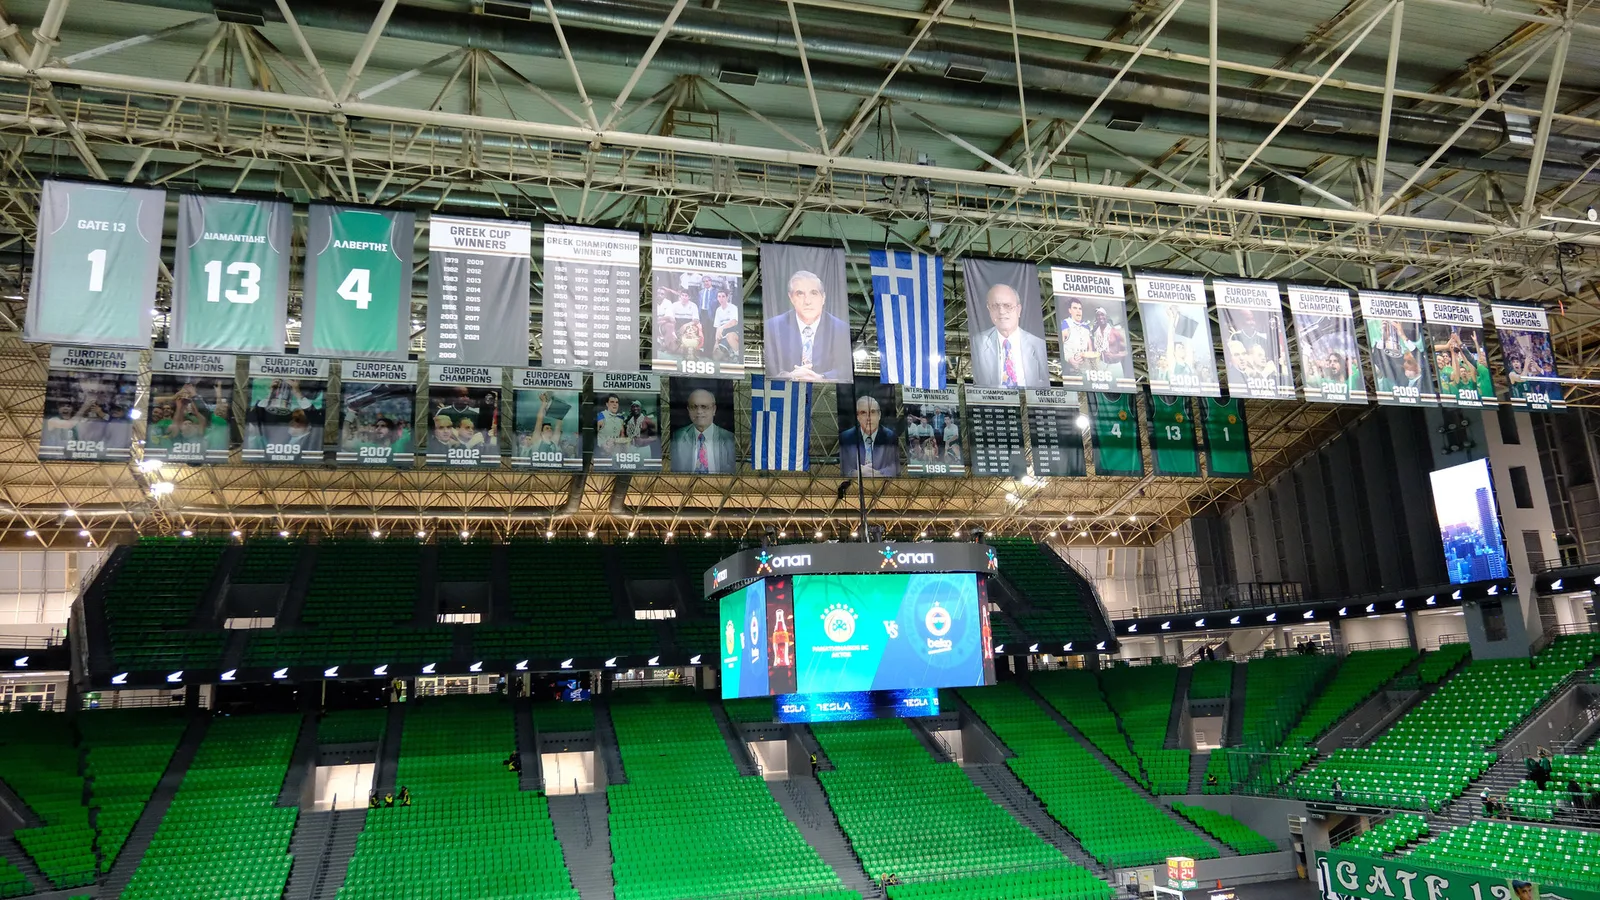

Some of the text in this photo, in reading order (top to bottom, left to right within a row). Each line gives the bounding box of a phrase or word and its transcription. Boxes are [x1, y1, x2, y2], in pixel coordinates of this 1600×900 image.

[77, 220, 126, 233] GATE 13
[203, 232, 266, 244] ΔΙΑΜΑΝΤΙΔΗΣ
[450, 226, 511, 239] GREEK CUP
[333, 239, 388, 252] ΑΛΒΕΡΤΗΣ
[454, 237, 506, 250] WINNERS
[546, 236, 638, 251] GREEK CHAMPIONSHIP
[573, 247, 612, 257] WINNERS
[655, 246, 738, 262] INTERCONTINENTAL
[666, 256, 727, 269] CUP WINNERS
[87, 248, 107, 292] 1
[204, 260, 262, 304] 13
[1065, 274, 1110, 286] EUROPEAN
[336, 268, 372, 310] 4
[1063, 282, 1114, 295] CHAMPIONS
[1149, 282, 1192, 292] EUROPEAN
[1148, 290, 1196, 302] CHAMPIONS
[1226, 288, 1268, 298] EUROPEAN
[1224, 296, 1272, 306] CHAMPIONS
[1300, 294, 1339, 304] EUROPEAN
[1371, 299, 1408, 310] EUROPEAN
[1298, 302, 1344, 312] CHAMPIONS
[1370, 307, 1412, 318] CHAMPIONS
[1434, 304, 1470, 314] EUROPEAN
[1432, 312, 1474, 322] CHAMPIONS
[1502, 310, 1538, 320] EUROPEAN
[1502, 318, 1542, 328] CHAMPIONS
[68, 349, 124, 360] EUROPEAN
[168, 354, 221, 364] EUROPEAN
[63, 357, 126, 368] CHAMPIONS
[164, 362, 224, 372] CHAMPIONS
[265, 358, 315, 367] EUROPEAN
[356, 362, 404, 372] EUROPEAN
[681, 360, 716, 374] 1996
[261, 365, 318, 376] CHAMPIONS
[352, 370, 407, 380] CHAMPIONS
[443, 366, 488, 376] EUROPEAN
[526, 371, 570, 380] EUROPEAN
[1086, 370, 1112, 382] 1996
[440, 374, 492, 384] CHAMPIONS
[522, 378, 573, 388] CHAMPIONS
[606, 374, 648, 382] EUROPEAN
[1170, 374, 1199, 386] 2000
[602, 381, 651, 389] CHAMPIONS
[1248, 378, 1276, 390] 2002
[1322, 382, 1348, 394] 2007
[1392, 386, 1419, 398] 2009
[1458, 389, 1478, 400] 2011
[1526, 393, 1550, 404] 2024
[1111, 424, 1122, 438] 4
[1165, 426, 1182, 440] 13
[1223, 426, 1230, 442] 1
[67, 440, 105, 452] 2024
[173, 442, 201, 453] 2011
[266, 444, 300, 454] 2009
[360, 446, 392, 457] 2007
[448, 448, 480, 458] 2002
[532, 452, 562, 462] 2000
[616, 452, 640, 462] 1996
[926, 464, 946, 474] 1996
[883, 620, 898, 638] VS
[816, 702, 852, 712] TESLA
[903, 698, 928, 706] TESLA
[1168, 868, 1178, 879] 24
[1182, 868, 1194, 879] 24
